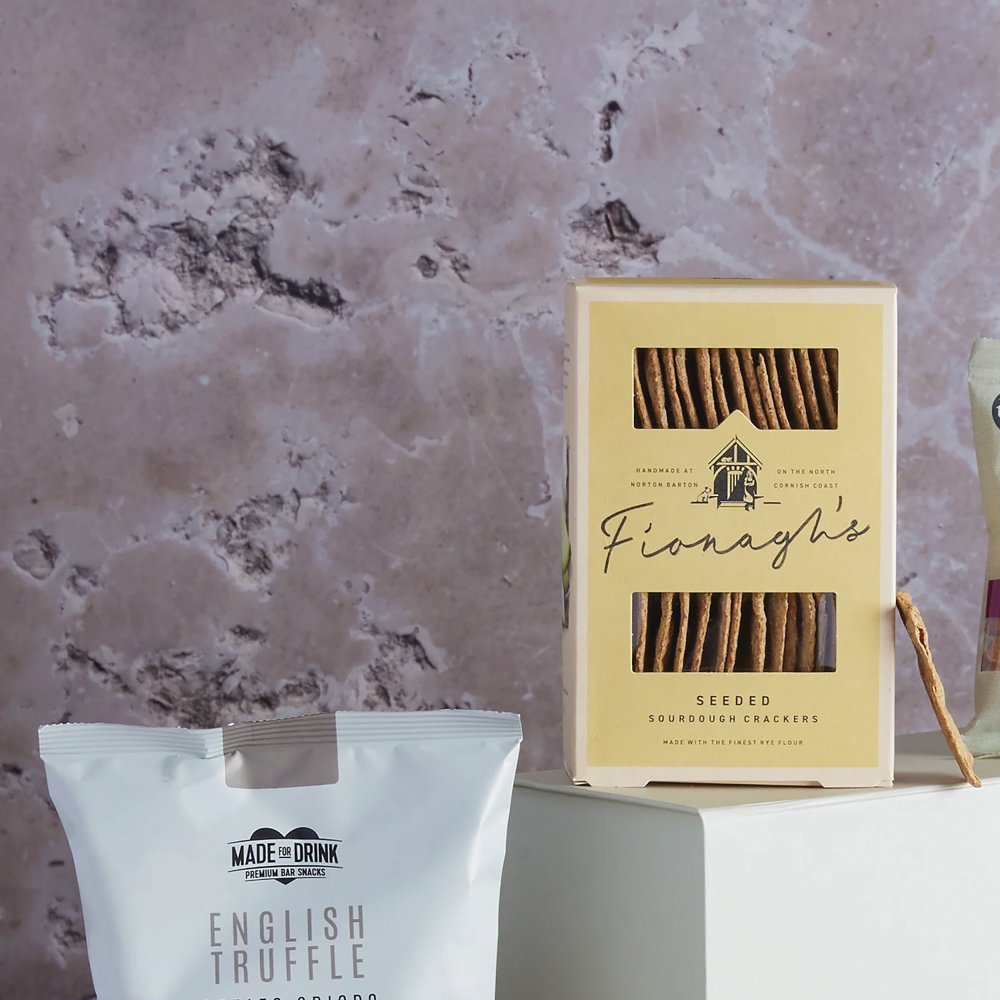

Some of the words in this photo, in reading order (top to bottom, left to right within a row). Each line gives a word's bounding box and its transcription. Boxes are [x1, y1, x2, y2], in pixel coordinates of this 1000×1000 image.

[600, 495, 870, 574] Fionagh's
[696, 695, 770, 706] SEEDED
[648, 714, 736, 723] SOURDOUGH
[743, 715, 819, 723] CRACKERS
[232, 842, 276, 867] MADE
[278, 846, 291, 856] FOR
[294, 842, 339, 864] DRINK
[245, 869, 278, 879] PREMIUM
[280, 868, 296, 877] BAR
[297, 868, 326, 877] SNACKS
[209, 905, 364, 947] ENGLISH
[210, 944, 364, 984] TRUFFLE
